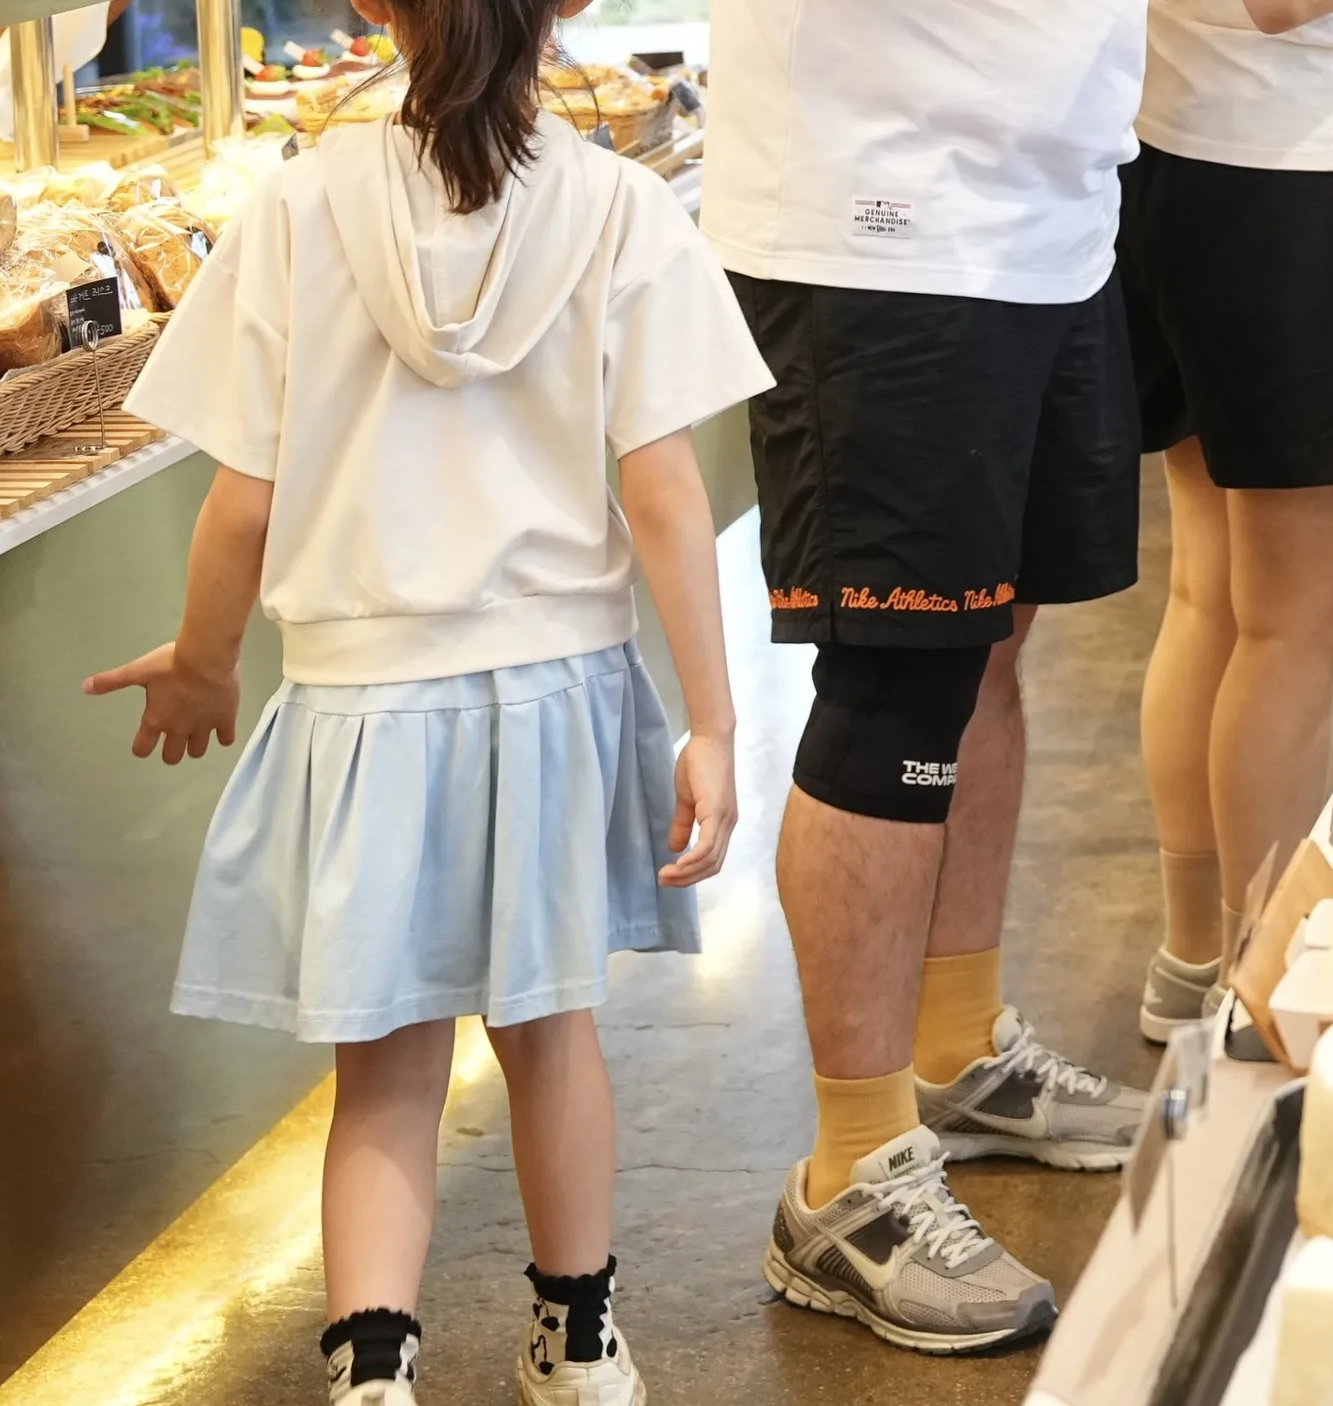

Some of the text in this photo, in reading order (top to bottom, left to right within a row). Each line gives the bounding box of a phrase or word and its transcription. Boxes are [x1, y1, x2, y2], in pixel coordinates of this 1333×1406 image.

[864, 208, 899, 219] GENUINE
[840, 585, 959, 613] Nike Athletics
[963, 587, 993, 612] Nike
[902, 759, 940, 775] THE
[888, 1145, 916, 1173] NIKE
